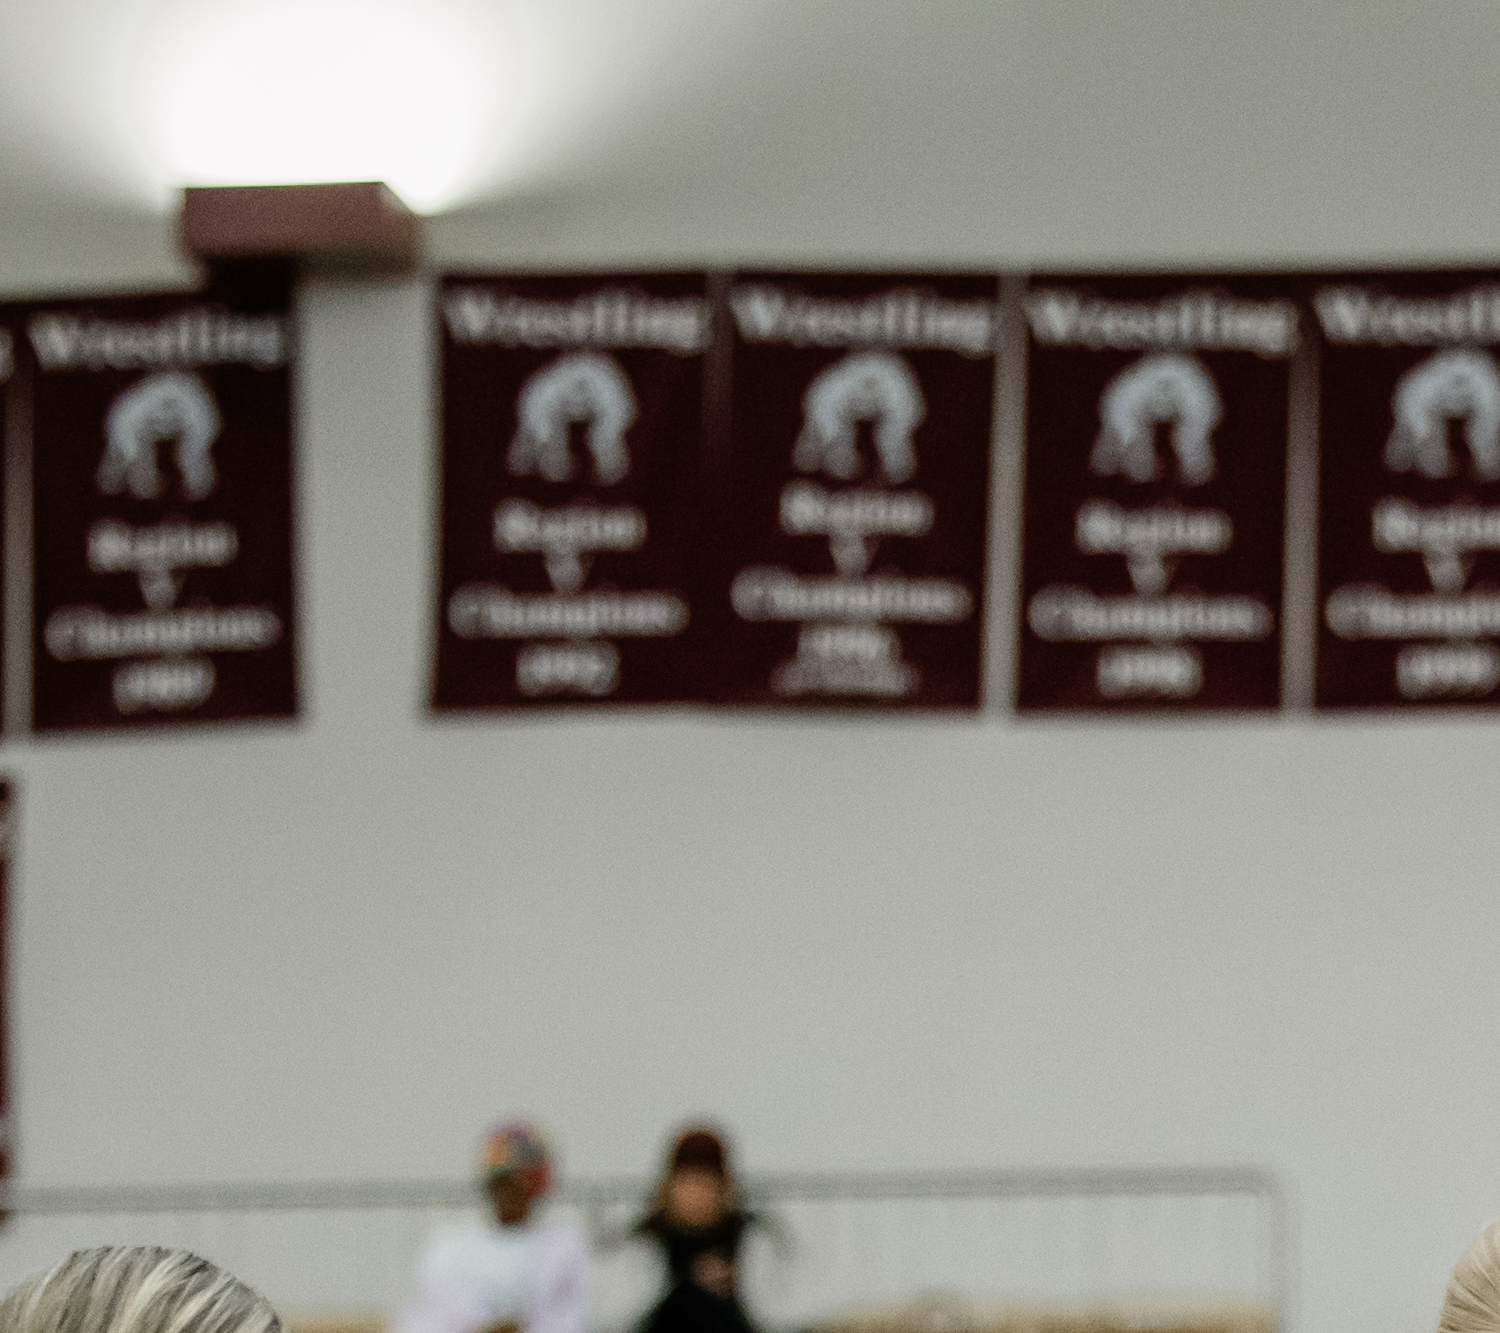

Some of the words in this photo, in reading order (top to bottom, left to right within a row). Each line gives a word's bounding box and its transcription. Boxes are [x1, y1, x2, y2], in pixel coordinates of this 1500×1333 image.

[29, 311, 295, 371] Wrestling
[444, 289, 709, 353] Wrestling
[730, 286, 998, 357] Wrestling
[1023, 289, 1295, 357] Wrestling
